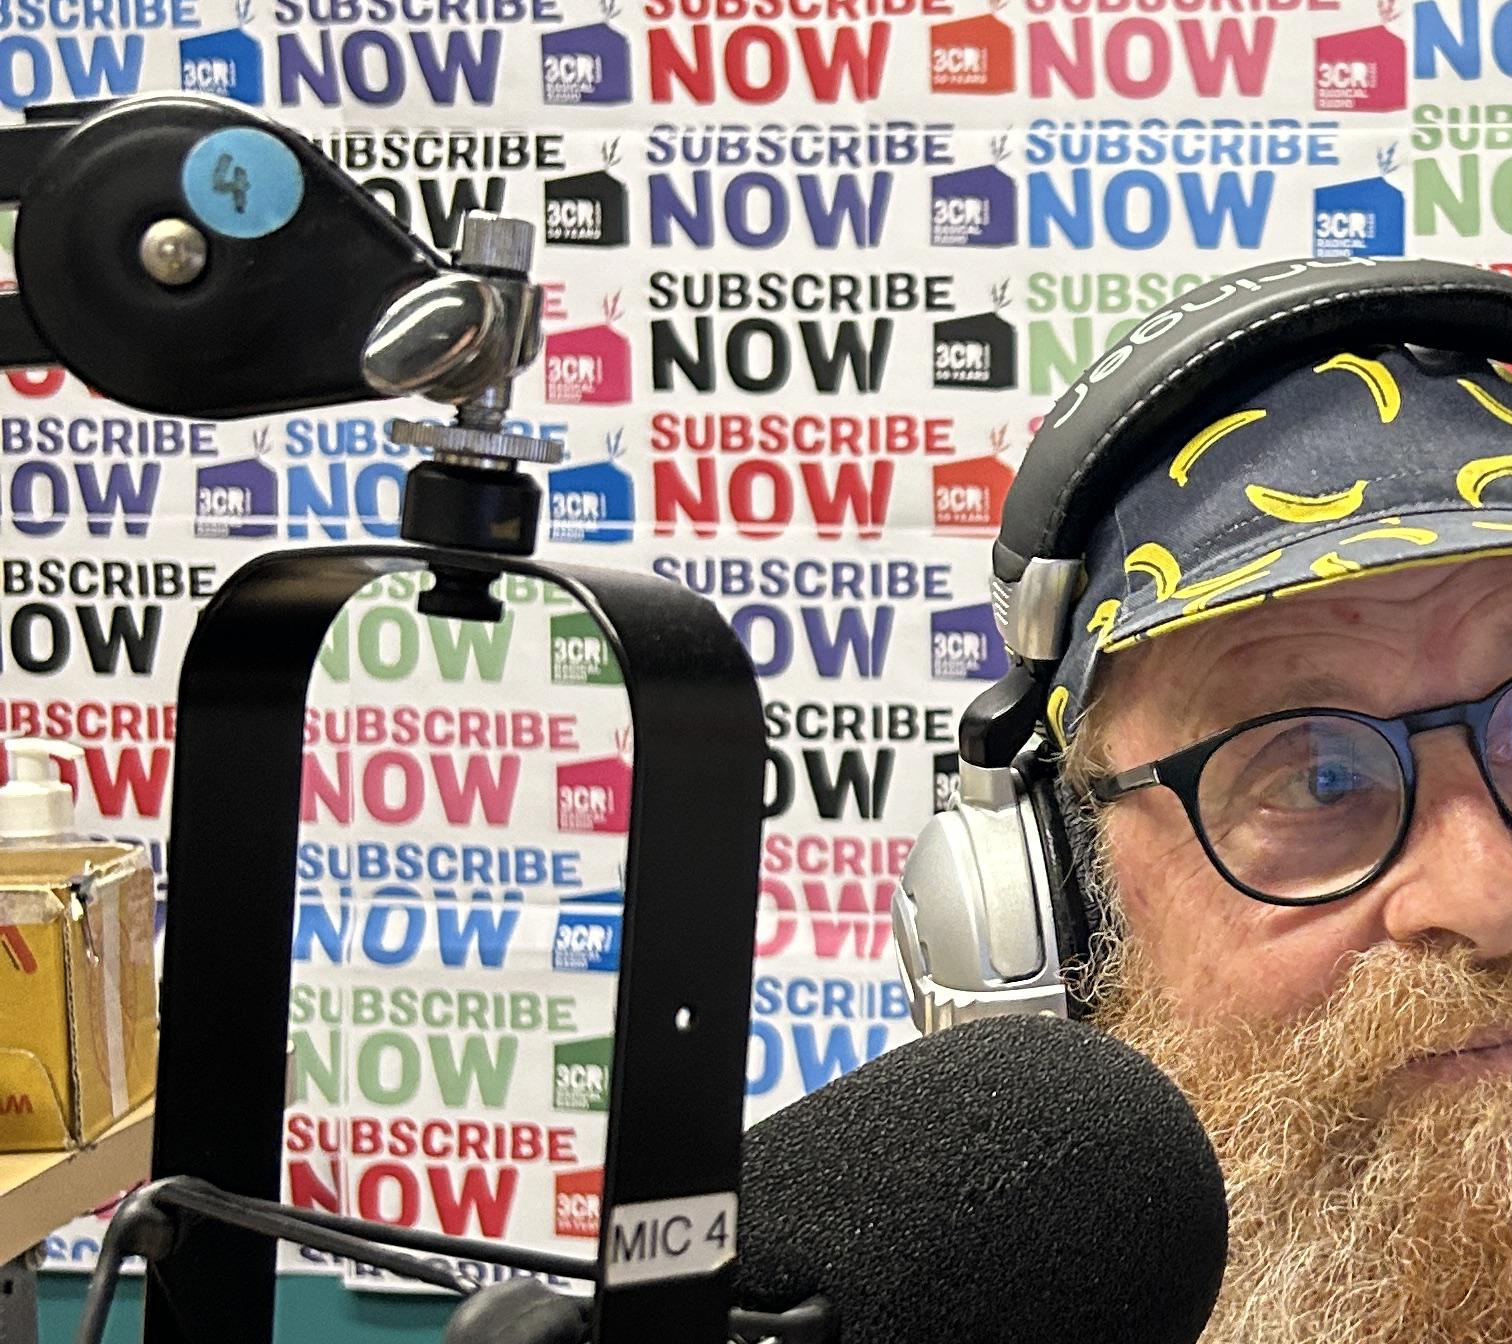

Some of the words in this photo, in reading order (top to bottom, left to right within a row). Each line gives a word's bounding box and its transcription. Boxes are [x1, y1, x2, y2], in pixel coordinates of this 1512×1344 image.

[277, 29, 501, 108] NOW
[647, 21, 890, 105] NOW
[1027, 16, 1276, 99] NOW
[212, 153, 252, 215] 4
[648, 170, 893, 250] NOW
[1027, 168, 1275, 250] NOW
[649, 271, 955, 314] SUBSCRIBE
[651, 316, 892, 394] NOW
[651, 413, 955, 456] SUBSCRIBE
[303, 707, 578, 748] SUBSCRIBE
[302, 750, 522, 826] NOW
[301, 842, 582, 884] SUBSCRIBE
[293, 986, 576, 1032] SUBSCRIBE
[612, 1215, 693, 1264] MIC
[705, 1210, 729, 1249] 4
